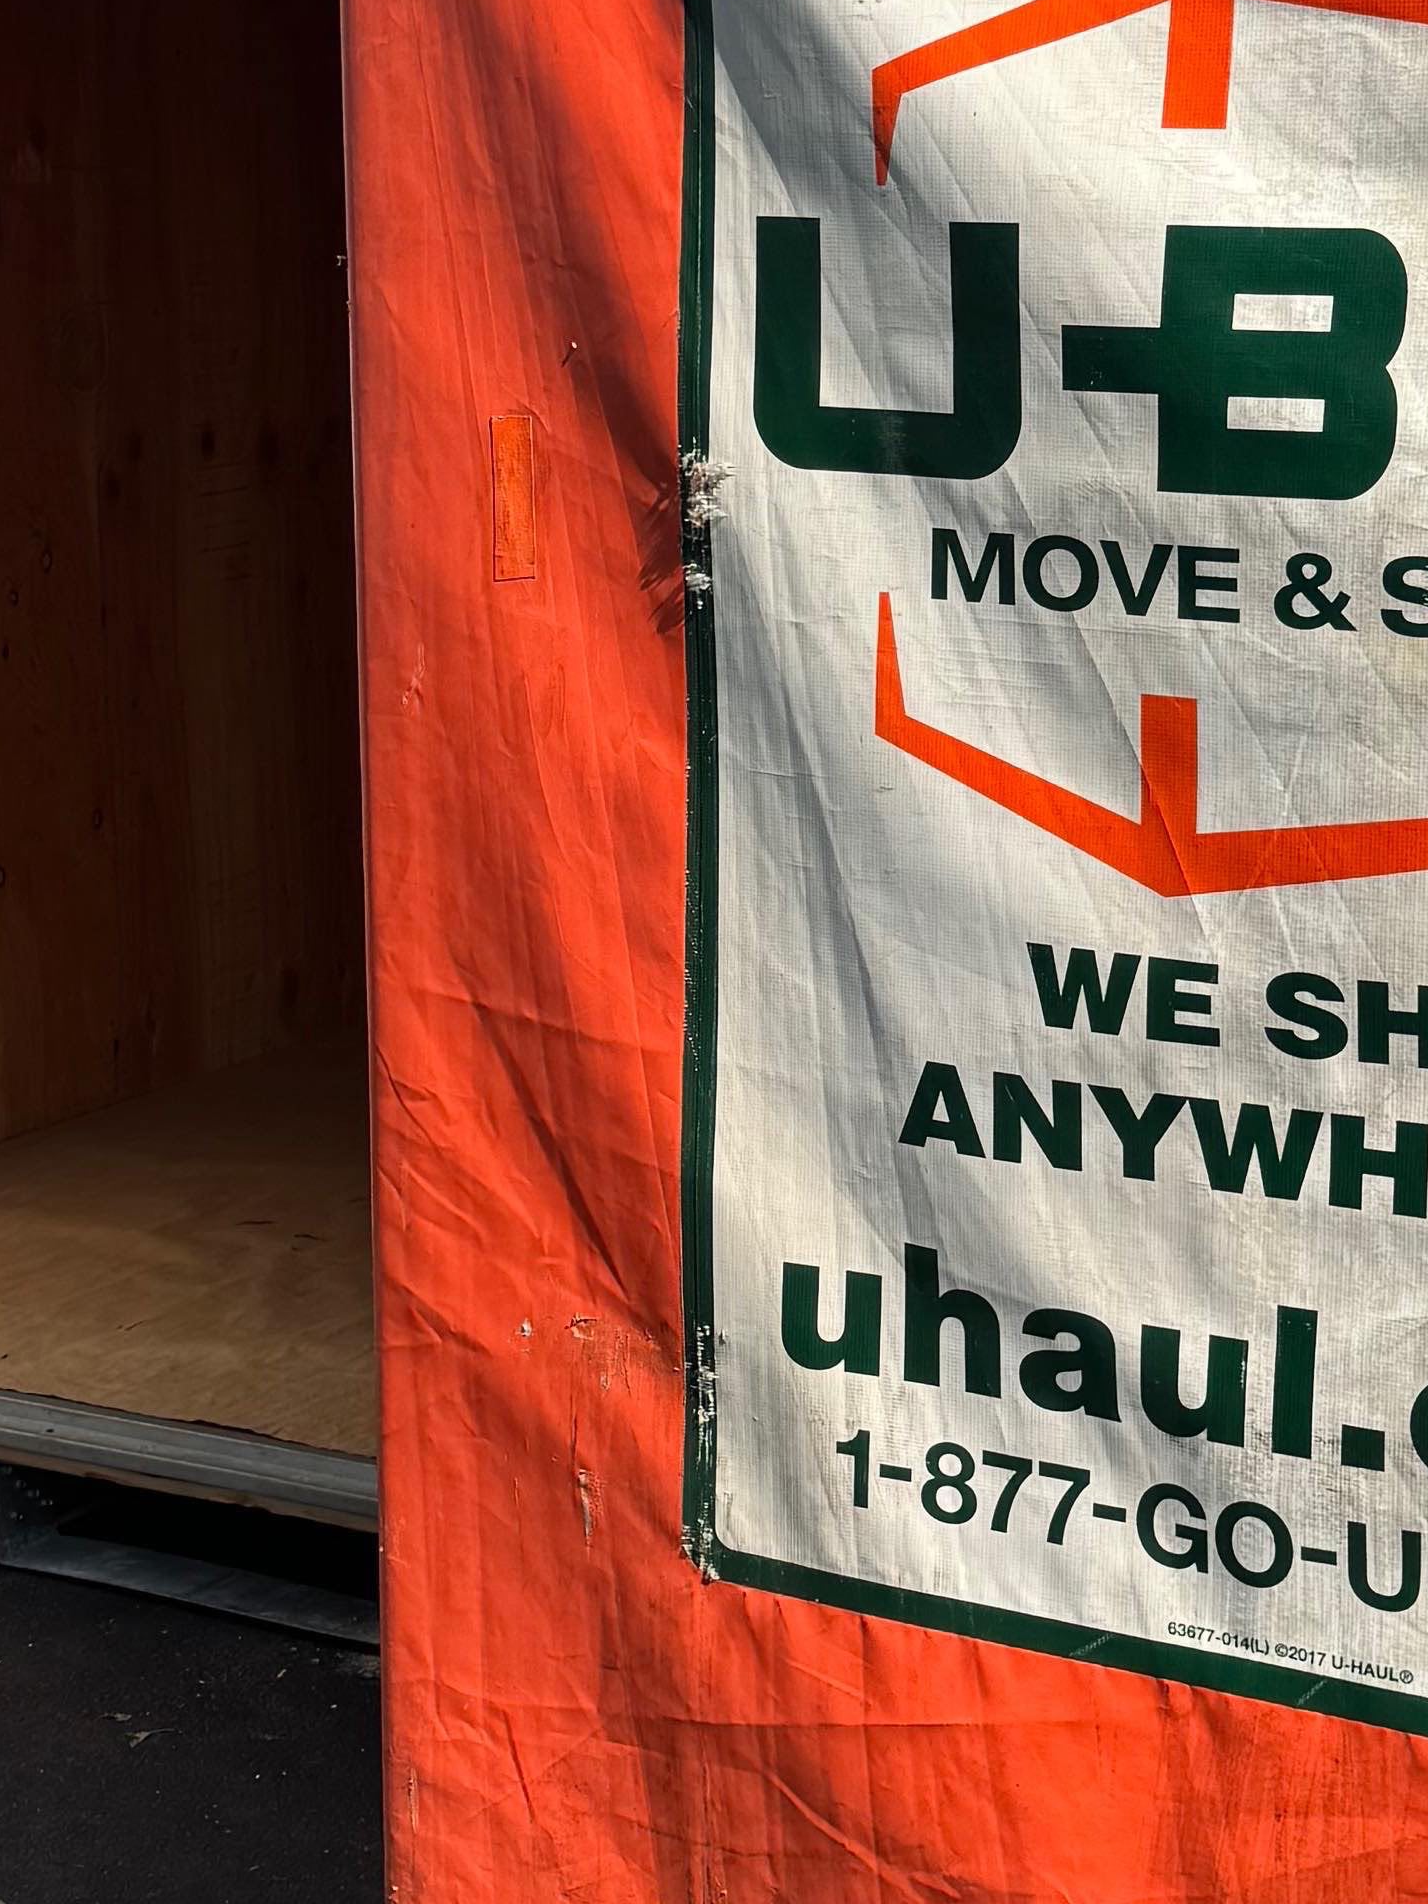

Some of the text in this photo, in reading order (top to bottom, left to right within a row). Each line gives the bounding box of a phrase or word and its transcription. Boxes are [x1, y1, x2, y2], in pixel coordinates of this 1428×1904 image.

[929, 527, 1237, 630] MOVE
[1273, 550, 1353, 634] &
[1025, 941, 1221, 1048] WE
